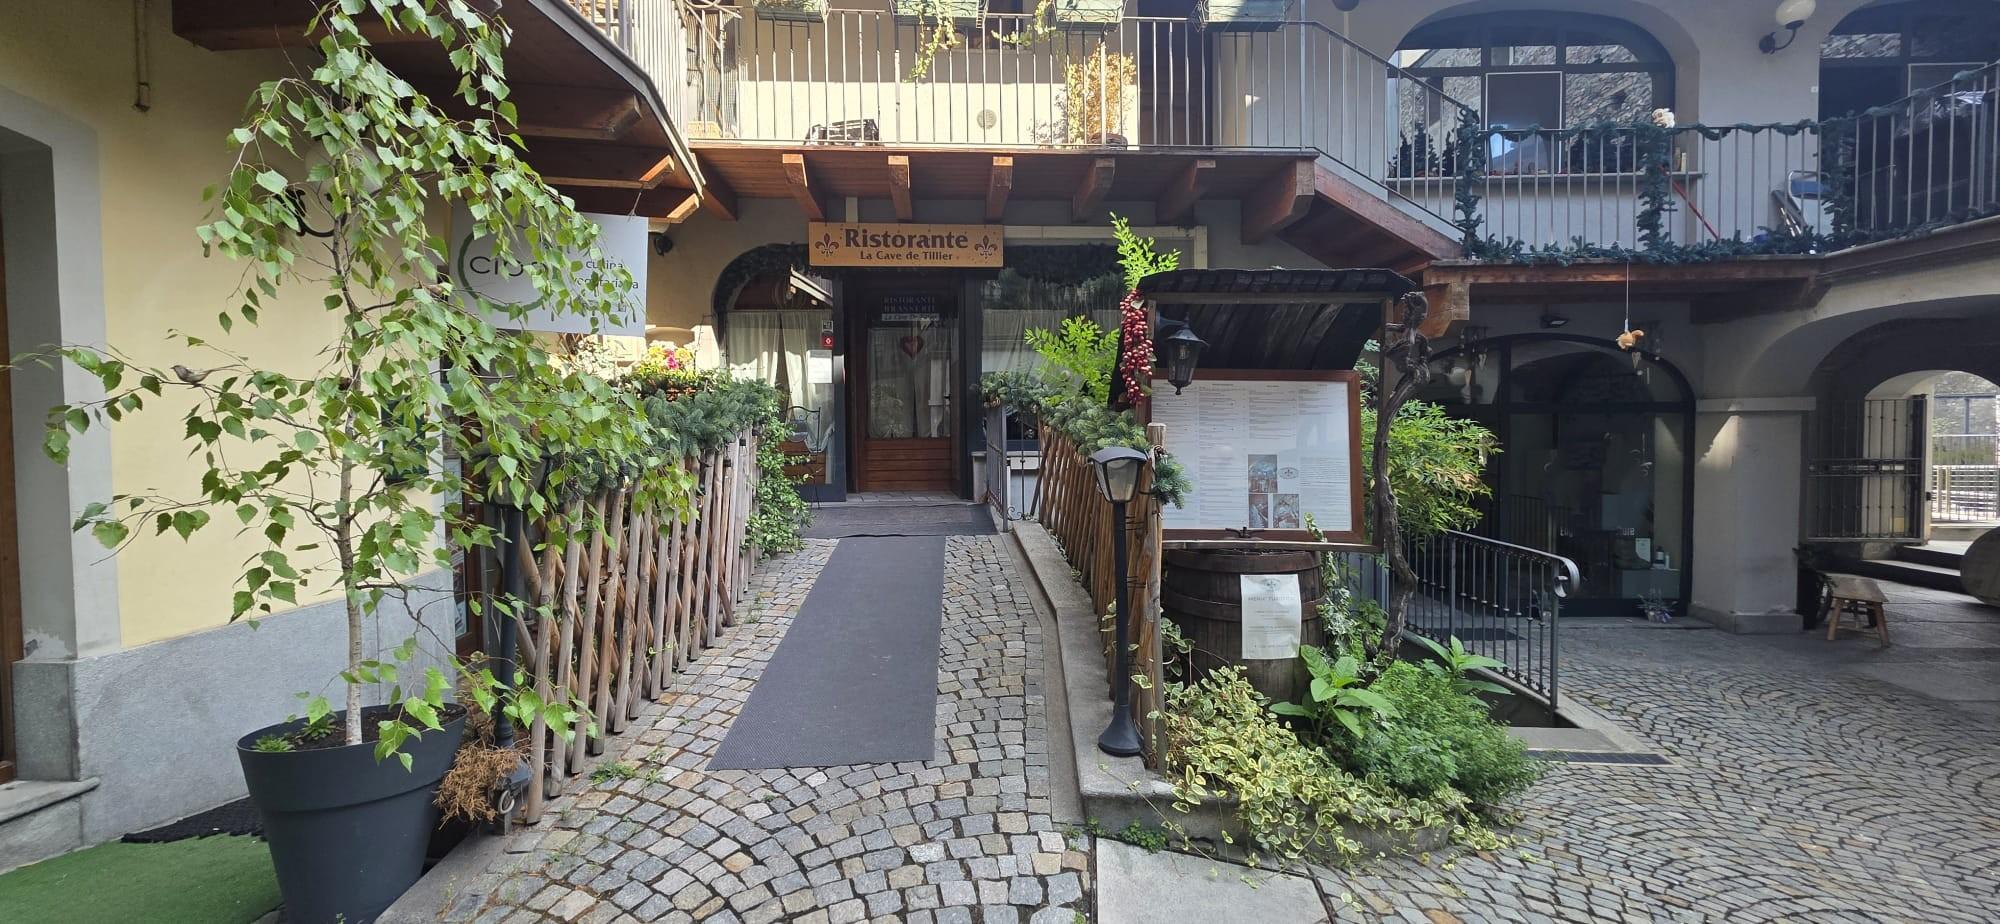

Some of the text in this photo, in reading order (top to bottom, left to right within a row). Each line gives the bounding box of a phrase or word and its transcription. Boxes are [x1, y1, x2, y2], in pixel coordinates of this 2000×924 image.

[844, 228, 969, 249] Ristorante
[860, 251, 953, 261] La Cave de Tillier
[585, 259, 624, 270] cuina
